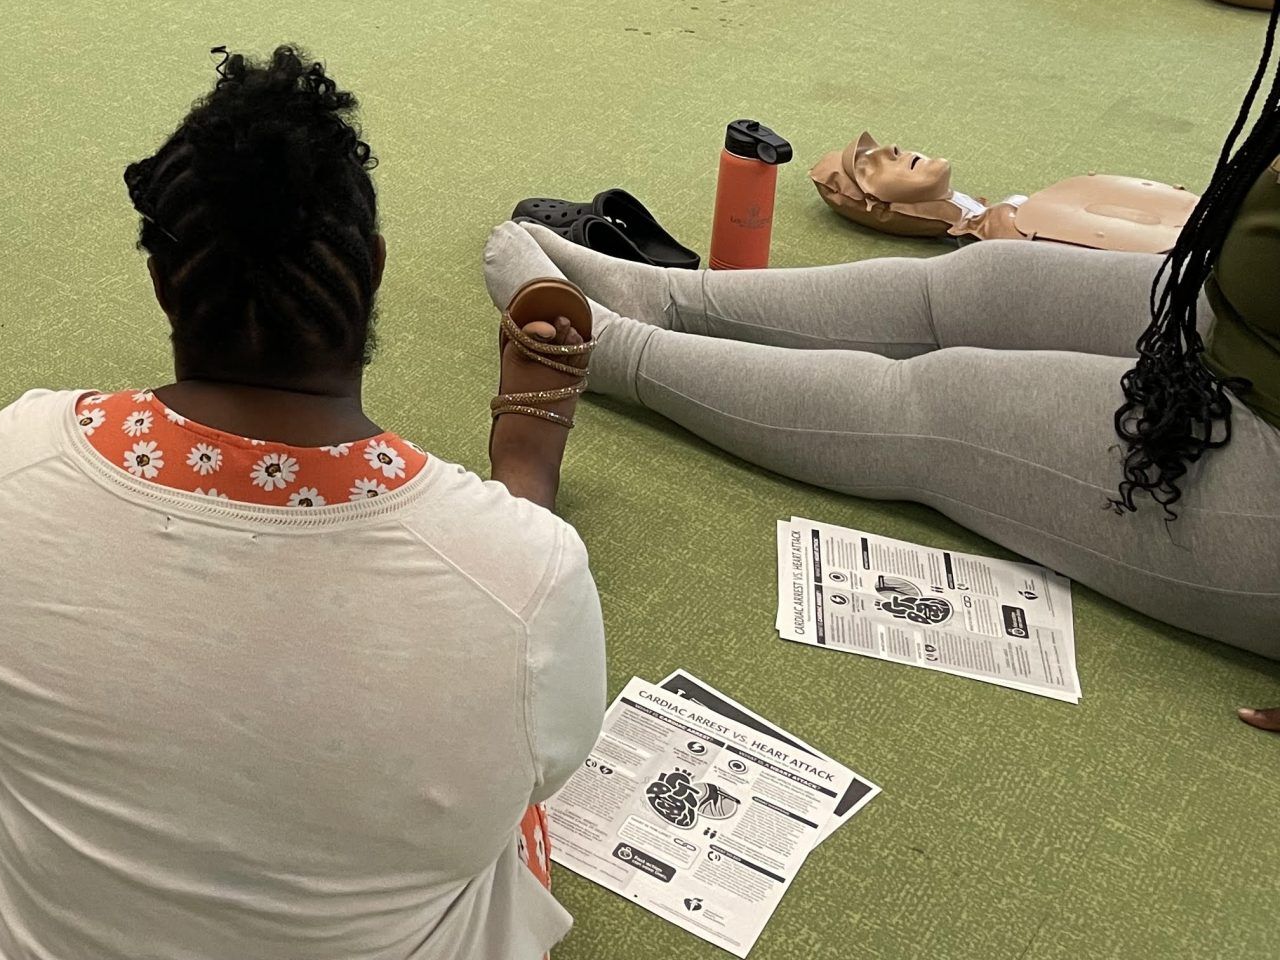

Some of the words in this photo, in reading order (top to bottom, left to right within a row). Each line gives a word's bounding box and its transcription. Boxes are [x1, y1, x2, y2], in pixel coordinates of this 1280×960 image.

[792, 530, 802, 552] ATTACK
[792, 551, 802, 570] HEART
[793, 581, 804, 606] ARREST
[794, 606, 805, 635] CARDIAC
[638, 689, 688, 717] CARDIAC
[687, 712, 731, 735] ARREST
[732, 730, 749, 744] VS.
[751, 739, 790, 762] HEART
[787, 759, 836, 783] ATTACK
